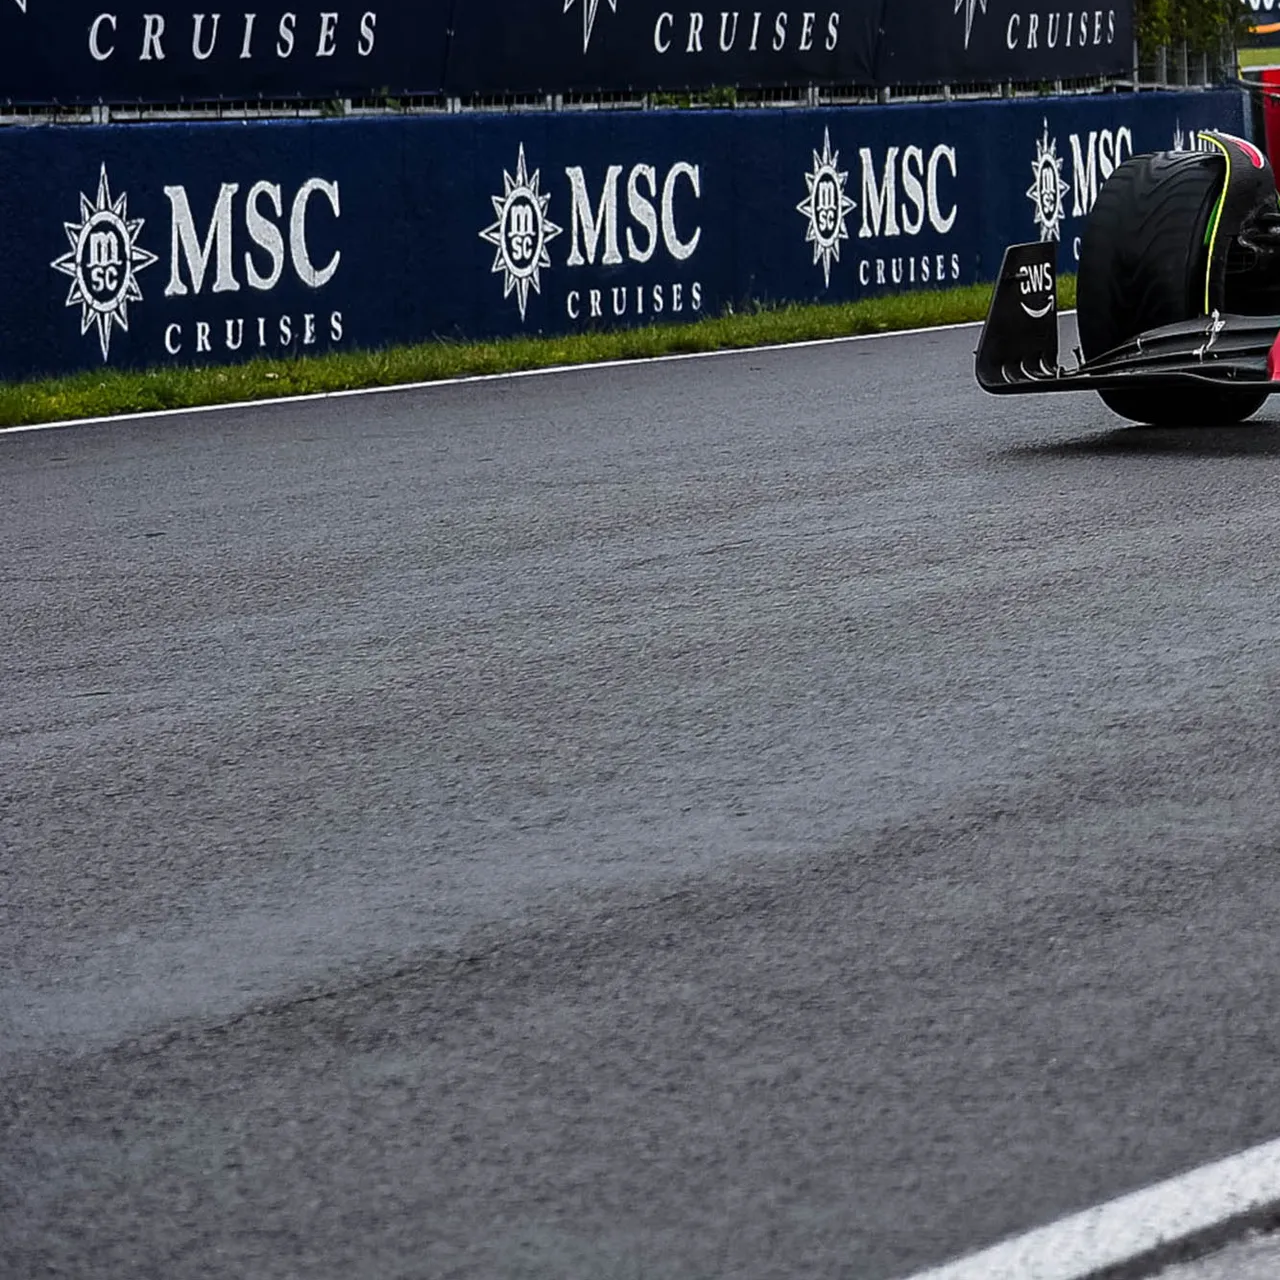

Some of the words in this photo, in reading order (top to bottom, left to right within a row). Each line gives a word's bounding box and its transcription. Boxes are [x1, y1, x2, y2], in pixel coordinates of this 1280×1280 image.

[89, 12, 377, 60] CRUISES
[655, 11, 839, 52] CRUISES
[1007, 10, 1114, 49] CRUISES
[859, 144, 957, 237] MSC
[566, 162, 701, 265] MSC
[164, 178, 341, 297] MSC
[860, 253, 960, 286] CRUISES
[1019, 262, 1053, 295] aws
[567, 282, 701, 319] CRUISES
[165, 312, 343, 355] CRUISES
